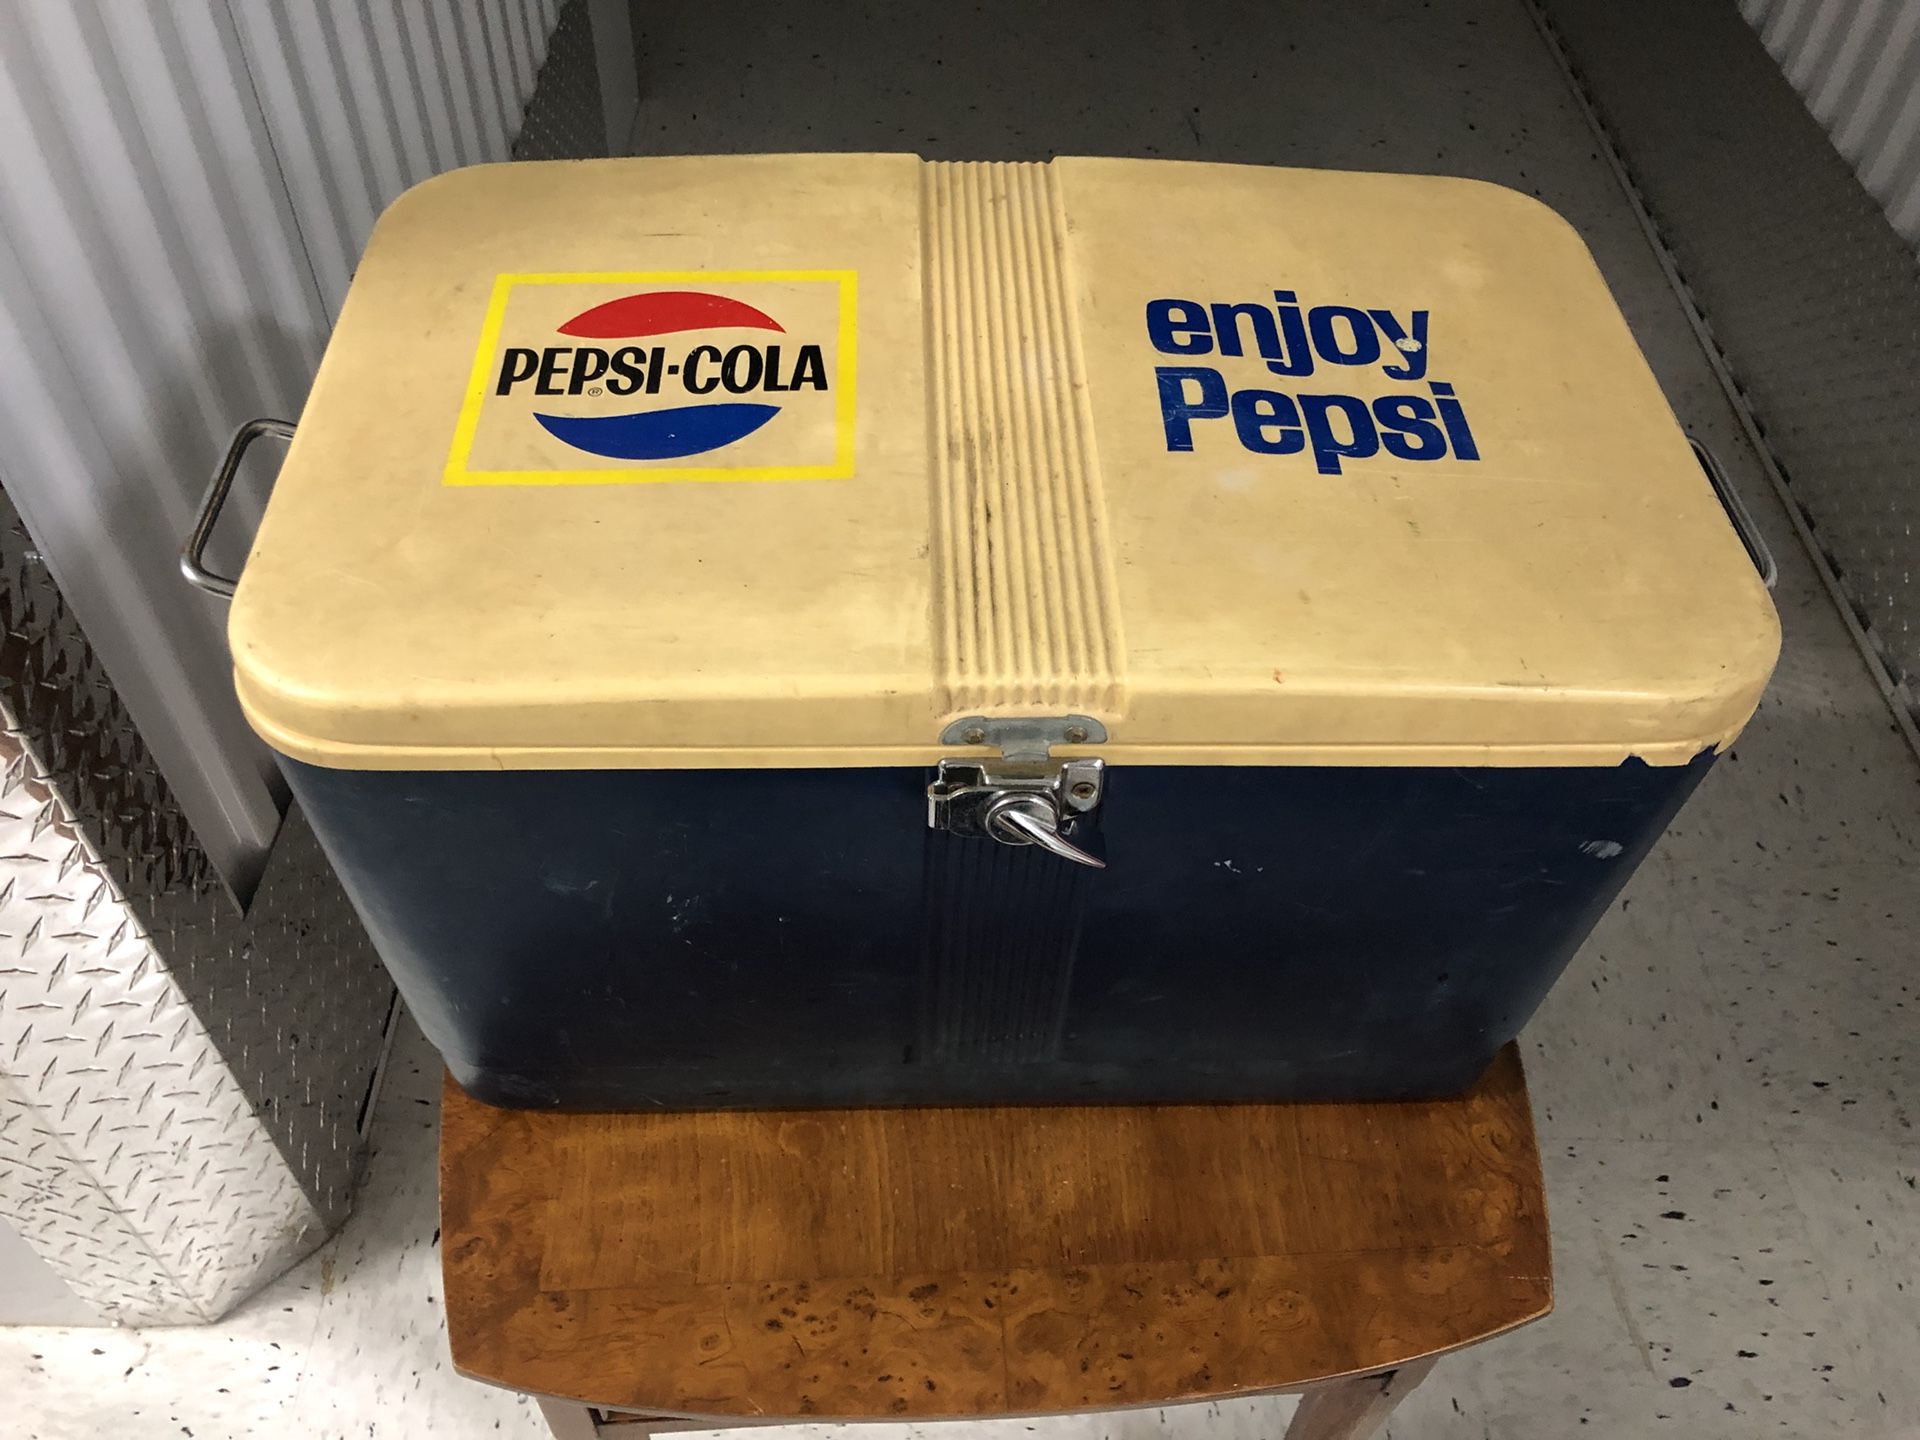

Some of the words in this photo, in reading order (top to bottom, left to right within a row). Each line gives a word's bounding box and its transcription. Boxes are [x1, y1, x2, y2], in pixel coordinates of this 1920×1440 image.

[495, 344, 828, 396] PEPSI-COLA
[1146, 289, 1430, 381] enjoy
[1154, 366, 1481, 476] Pepsi
